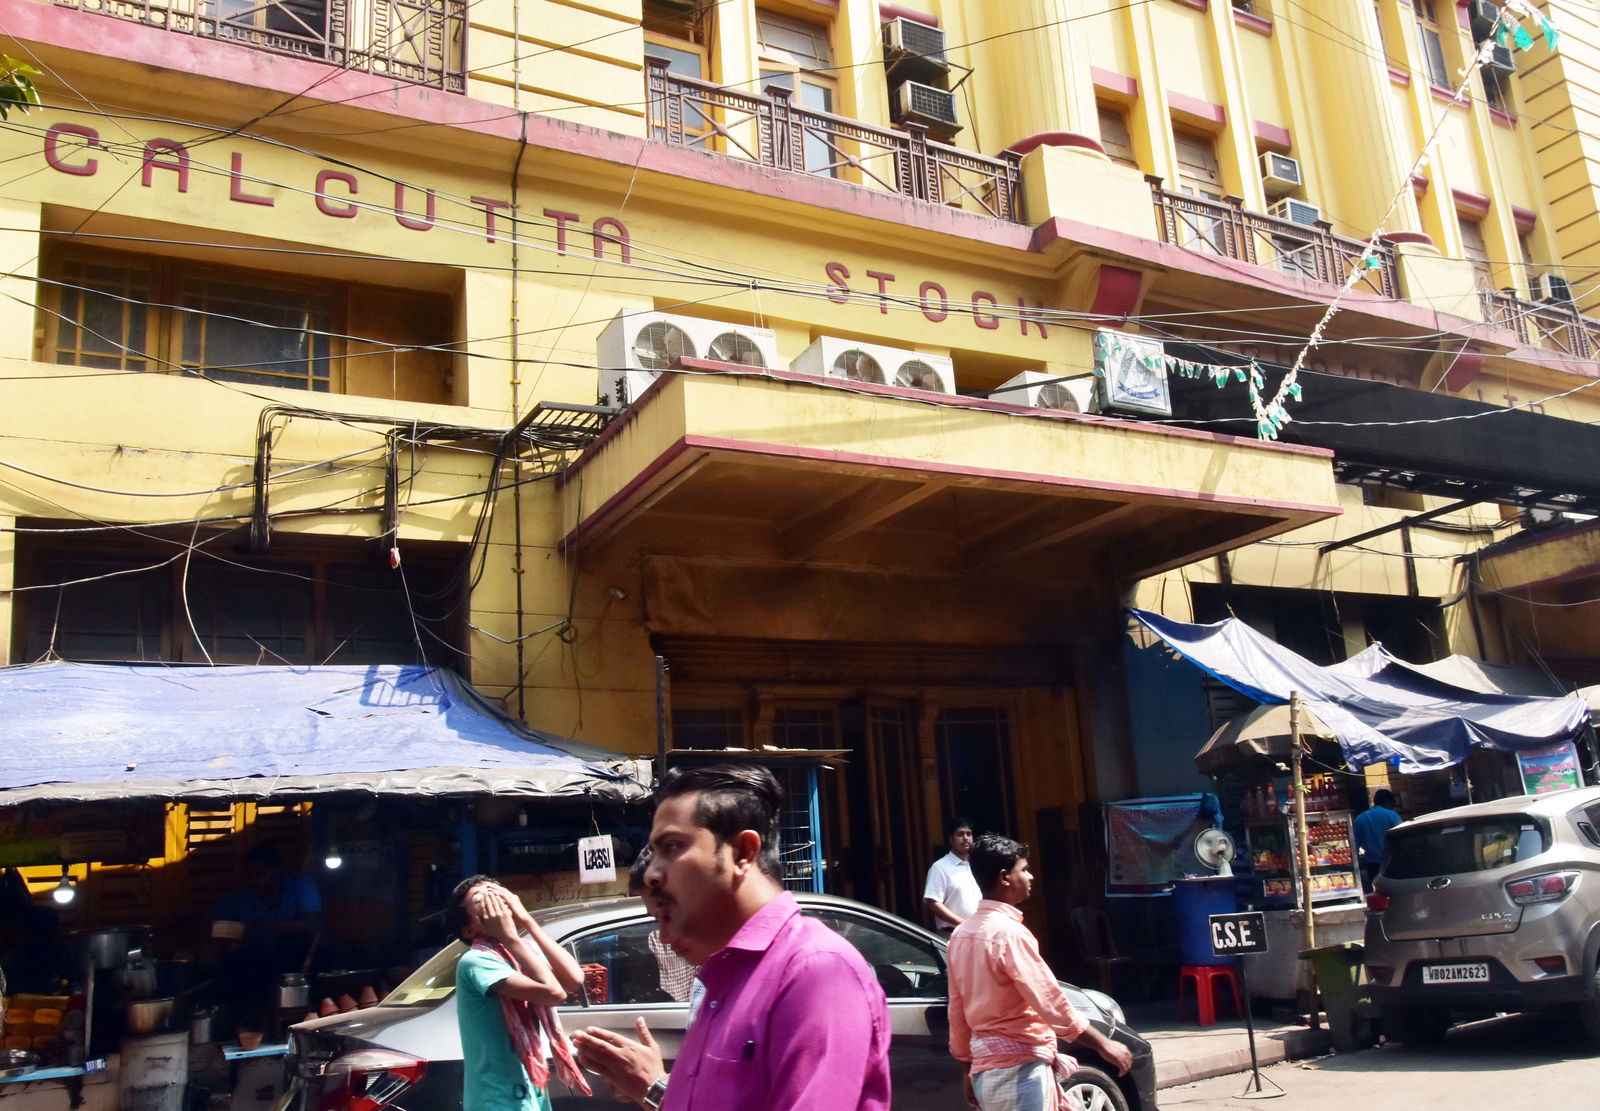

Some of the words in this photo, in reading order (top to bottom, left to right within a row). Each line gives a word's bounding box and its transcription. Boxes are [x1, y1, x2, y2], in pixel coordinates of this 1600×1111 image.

[43, 122, 632, 264] CALCUTTA
[824, 261, 1048, 340] STOCK
[1211, 920, 1256, 949] C.S.E.
[1428, 966, 1487, 980] WB02AM2623
